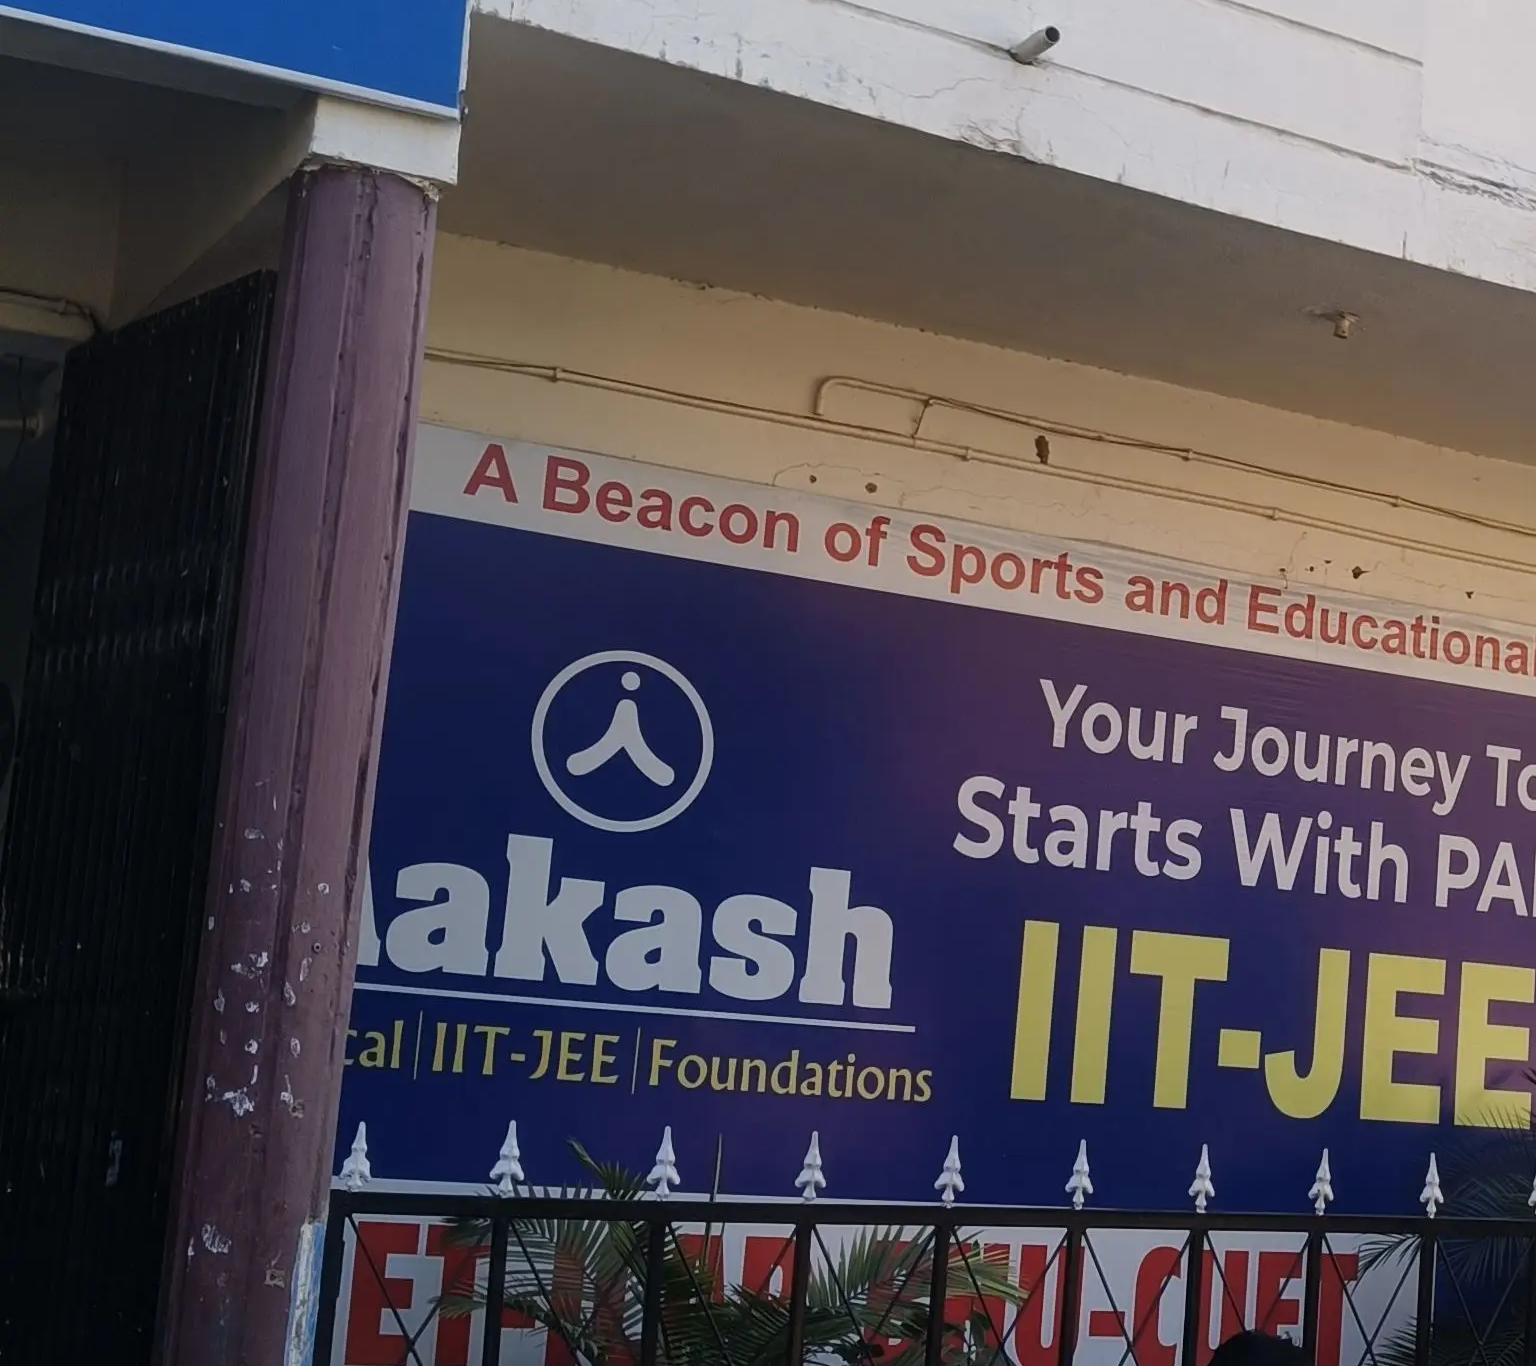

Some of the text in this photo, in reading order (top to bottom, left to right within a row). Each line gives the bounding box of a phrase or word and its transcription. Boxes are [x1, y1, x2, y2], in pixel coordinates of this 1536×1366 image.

[463, 443, 518, 504] A
[542, 454, 799, 553] Beacon
[824, 516, 891, 567] of
[906, 524, 1105, 604] Sports
[1124, 574, 1228, 626] and
[1039, 678, 1198, 765] Your
[1213, 705, 1471, 816] Journey
[953, 775, 1203, 881] Starts
[1229, 808, 1409, 904] With
[432, 1021, 620, 1084] IIT-JEE
[649, 1038, 933, 1103] Foundations
[1010, 919, 1536, 1131] IIT-JEE
